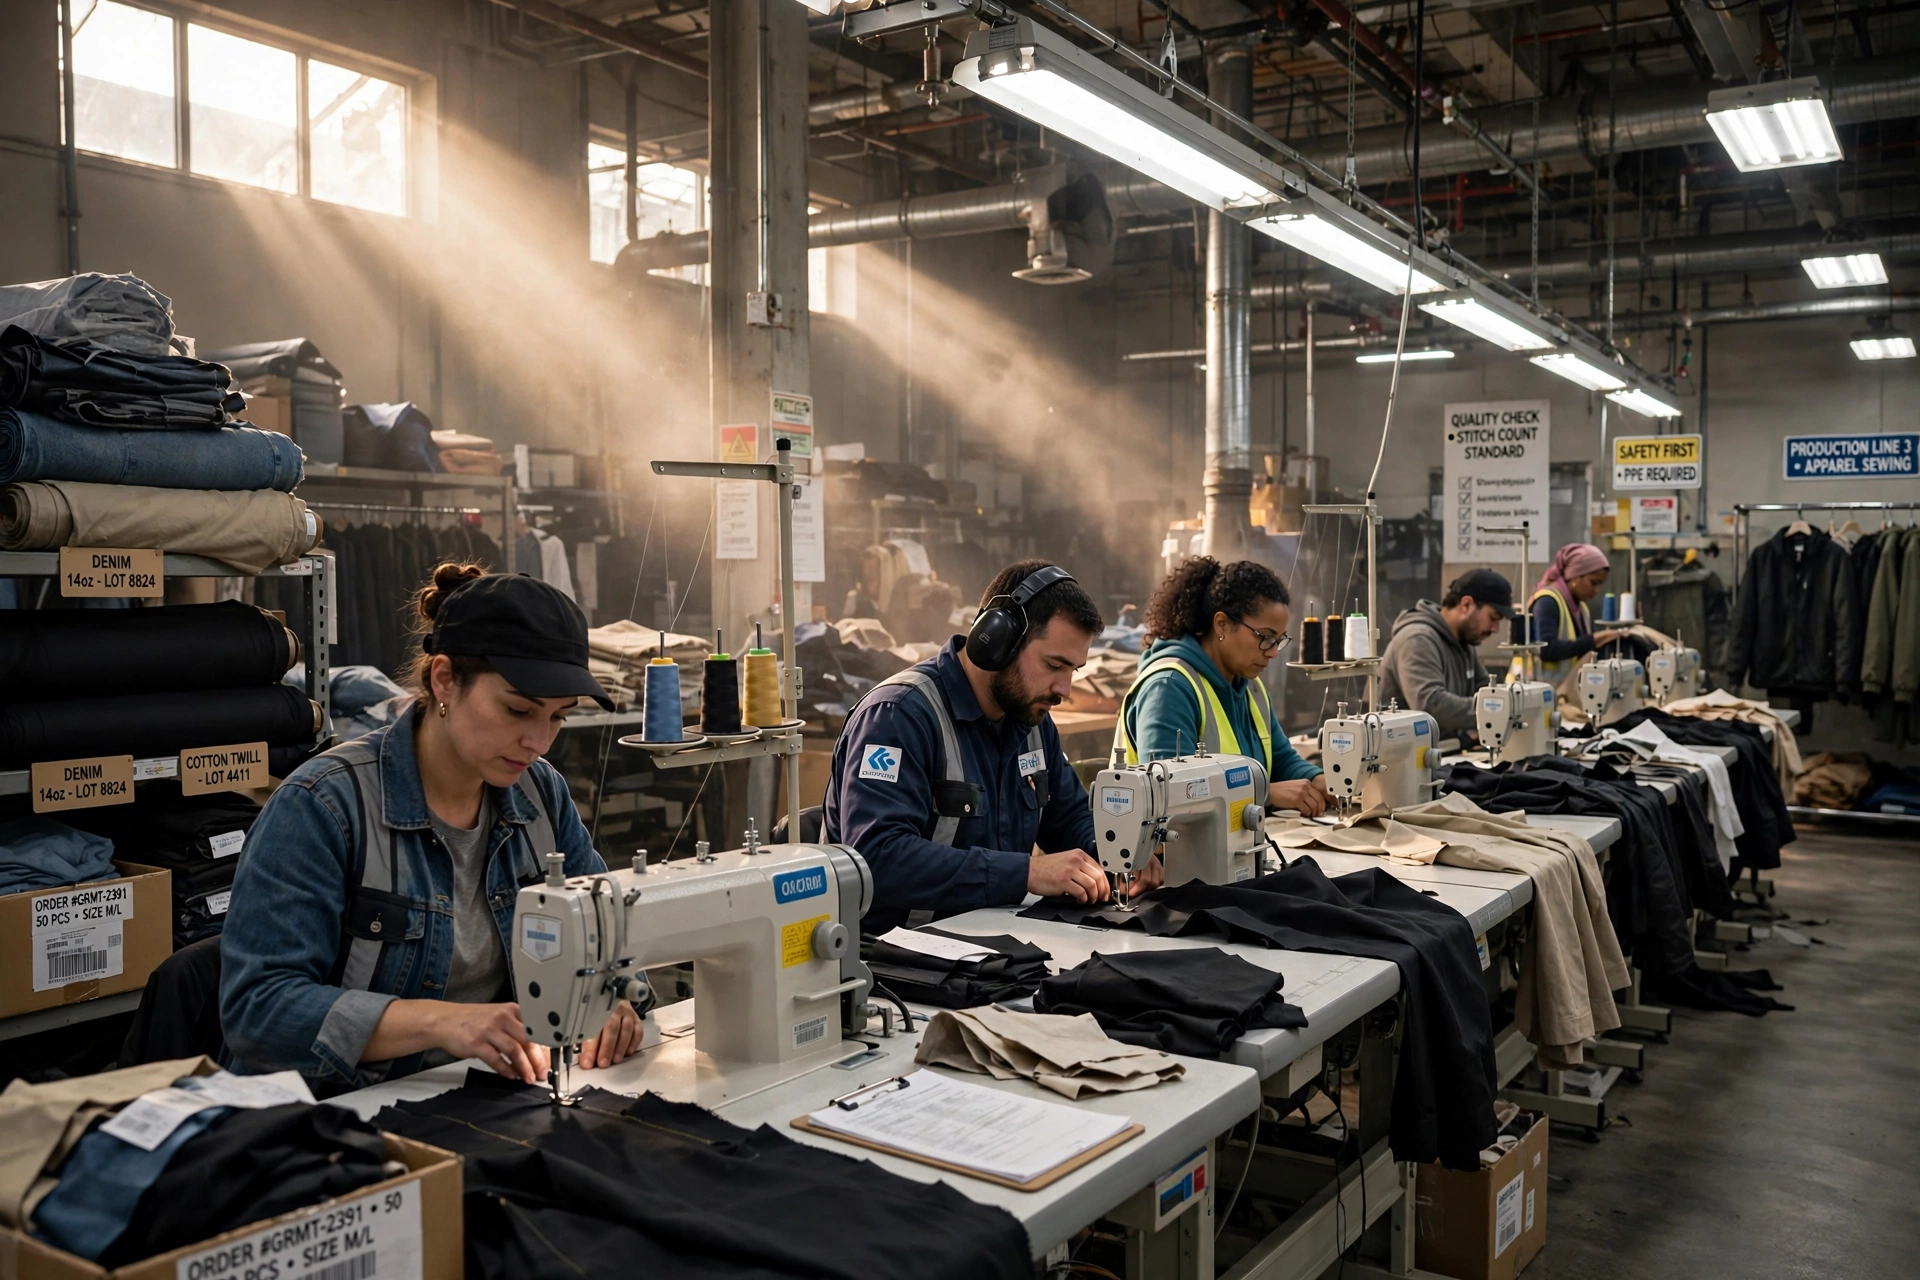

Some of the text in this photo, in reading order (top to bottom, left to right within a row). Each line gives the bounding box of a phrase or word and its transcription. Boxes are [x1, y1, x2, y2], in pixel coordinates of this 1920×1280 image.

[1451, 410, 1540, 428] QUALITY CHECK
[1457, 429, 1495, 444] STITCH
[1498, 427, 1538, 441] COUNT
[1464, 444, 1525, 460] STANDARD
[1620, 442, 1695, 459] SAFETY FIRST
[1790, 438, 1912, 457] PRODUCTION LINE 3
[1804, 458, 1859, 473] APPAREL
[1862, 456, 1911, 472] SEWING
[1624, 467, 1643, 482] PPE
[1647, 466, 1696, 483] REQUIRED
[92, 554, 131, 569] DENIM
[67, 573, 94, 588] 14oz
[104, 573, 126, 588] LOT
[128, 574, 156, 588] 8824
[186, 750, 261, 769] COTTON TWILL
[64, 764, 102, 781] DENIM
[205, 770, 225, 785] LOT
[226, 768, 250, 783] 4411
[39, 787, 66, 802] 14oz
[76, 783, 97, 798] LOT
[100, 781, 126, 796] 8824
[35, 896, 68, 912] ORDER
[36, 915, 49, 928] 50
[51, 912, 70, 926] PCS
[82, 906, 103, 920] SIZE
[105, 904, 122, 917] M/L
[187, 1243, 254, 1280] ORDER
[260, 1206, 363, 1256] #GRMT-2391
[384, 1191, 403, 1213] 50
[302, 1236, 339, 1268] SIZE
[344, 1225, 374, 1250] M/L
